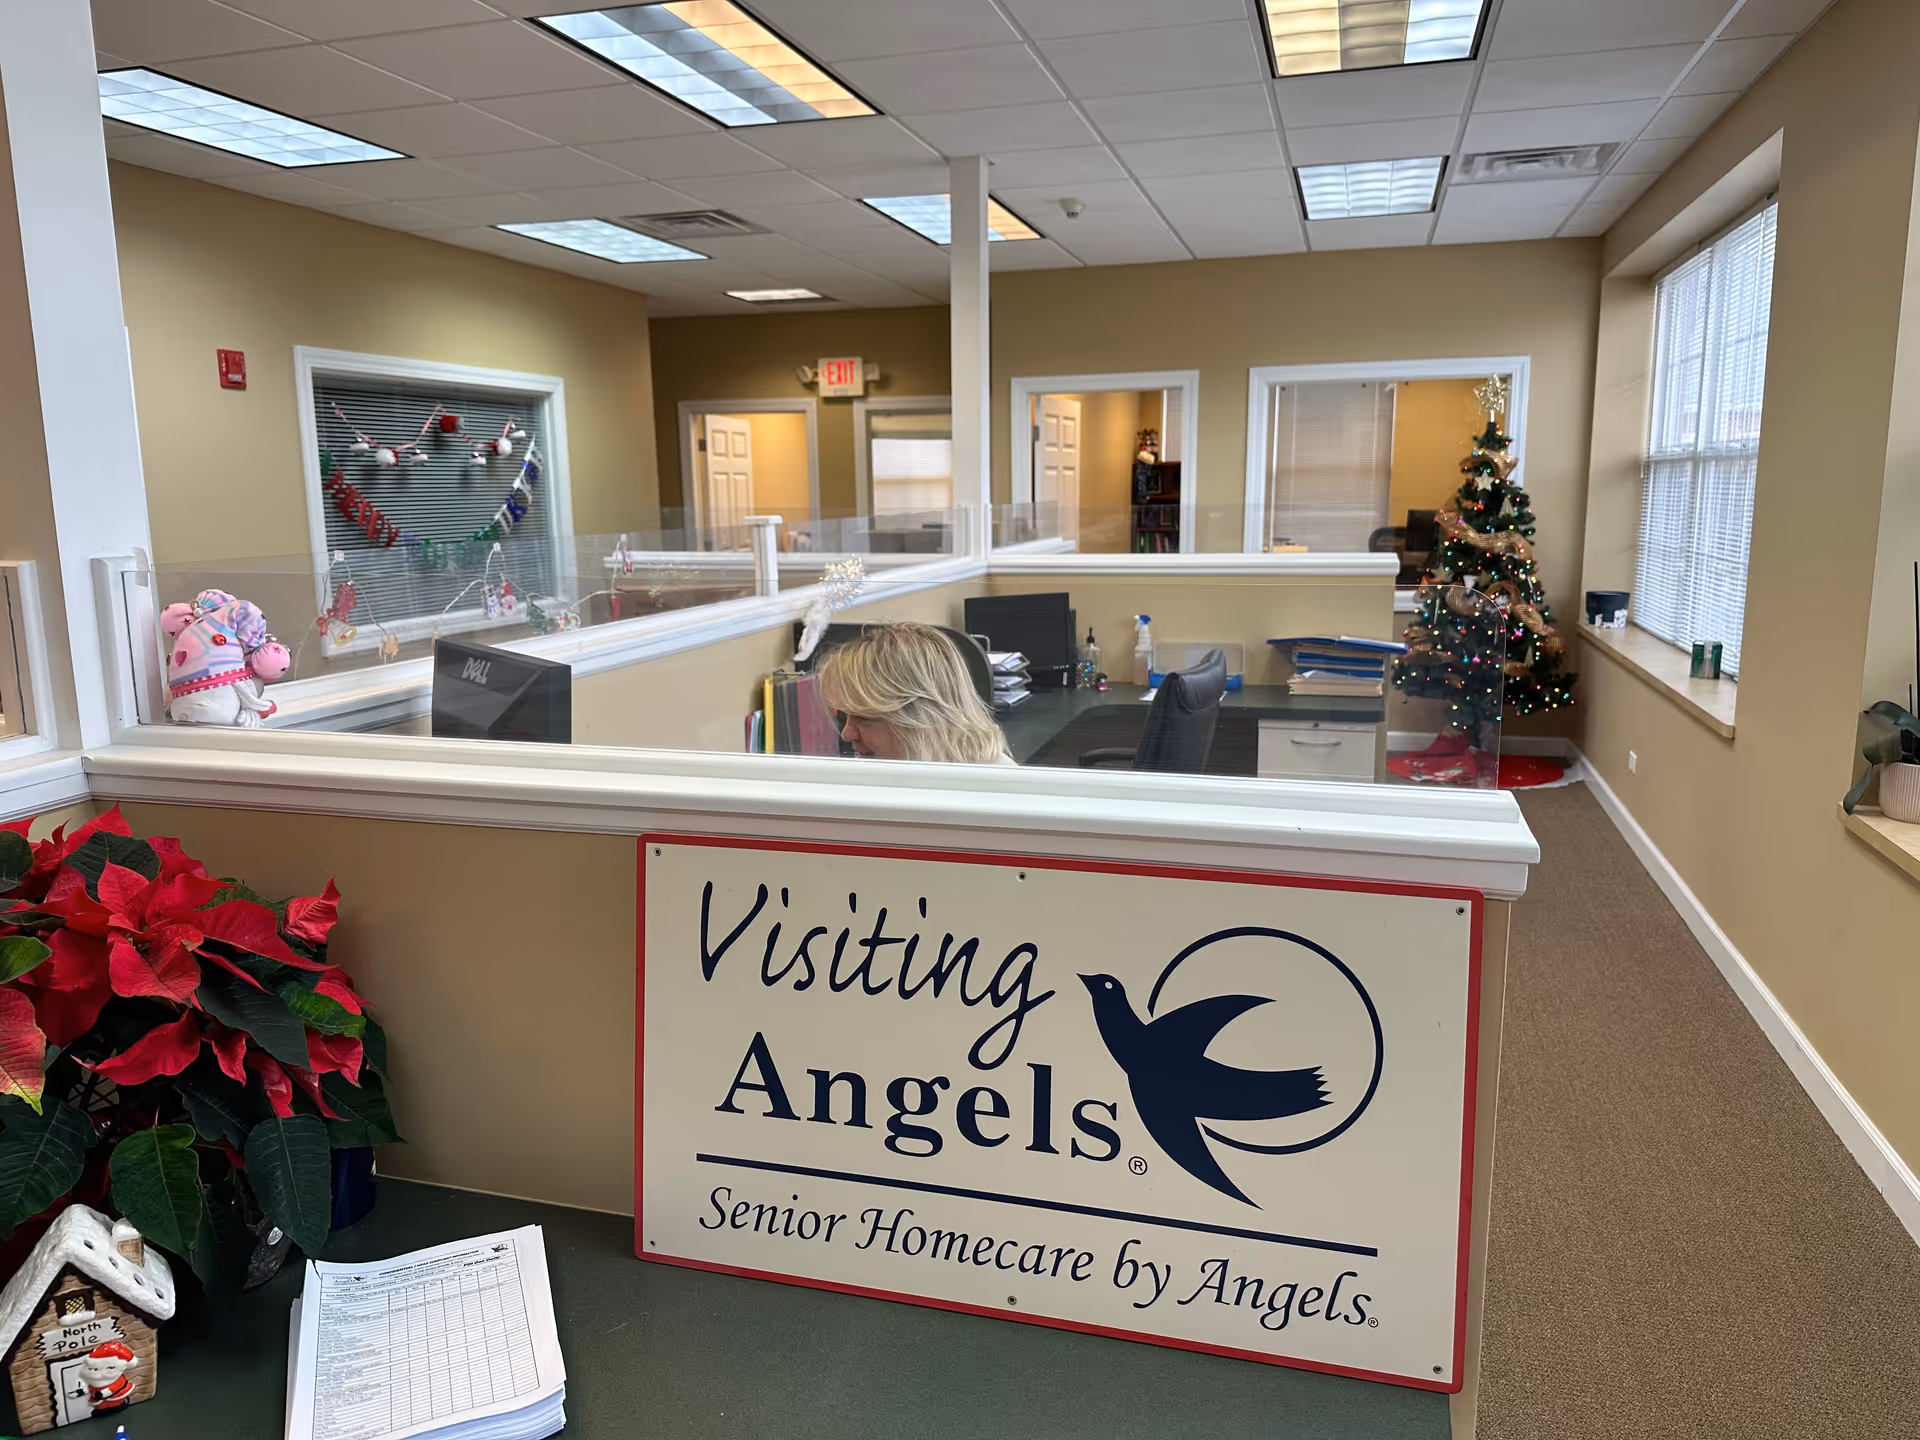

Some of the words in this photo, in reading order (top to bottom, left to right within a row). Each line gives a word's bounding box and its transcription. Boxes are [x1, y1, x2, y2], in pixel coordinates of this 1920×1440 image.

[827, 360, 855, 386] EXIT
[461, 656, 491, 685] DELL
[701, 880, 1056, 1071] Visiting
[698, 1186, 848, 1243] Senior
[854, 1208, 1094, 1282] Homecare
[1112, 1238, 1172, 1309] by
[52, 1335, 100, 1352] Pole
[63, 1322, 101, 1338] North
